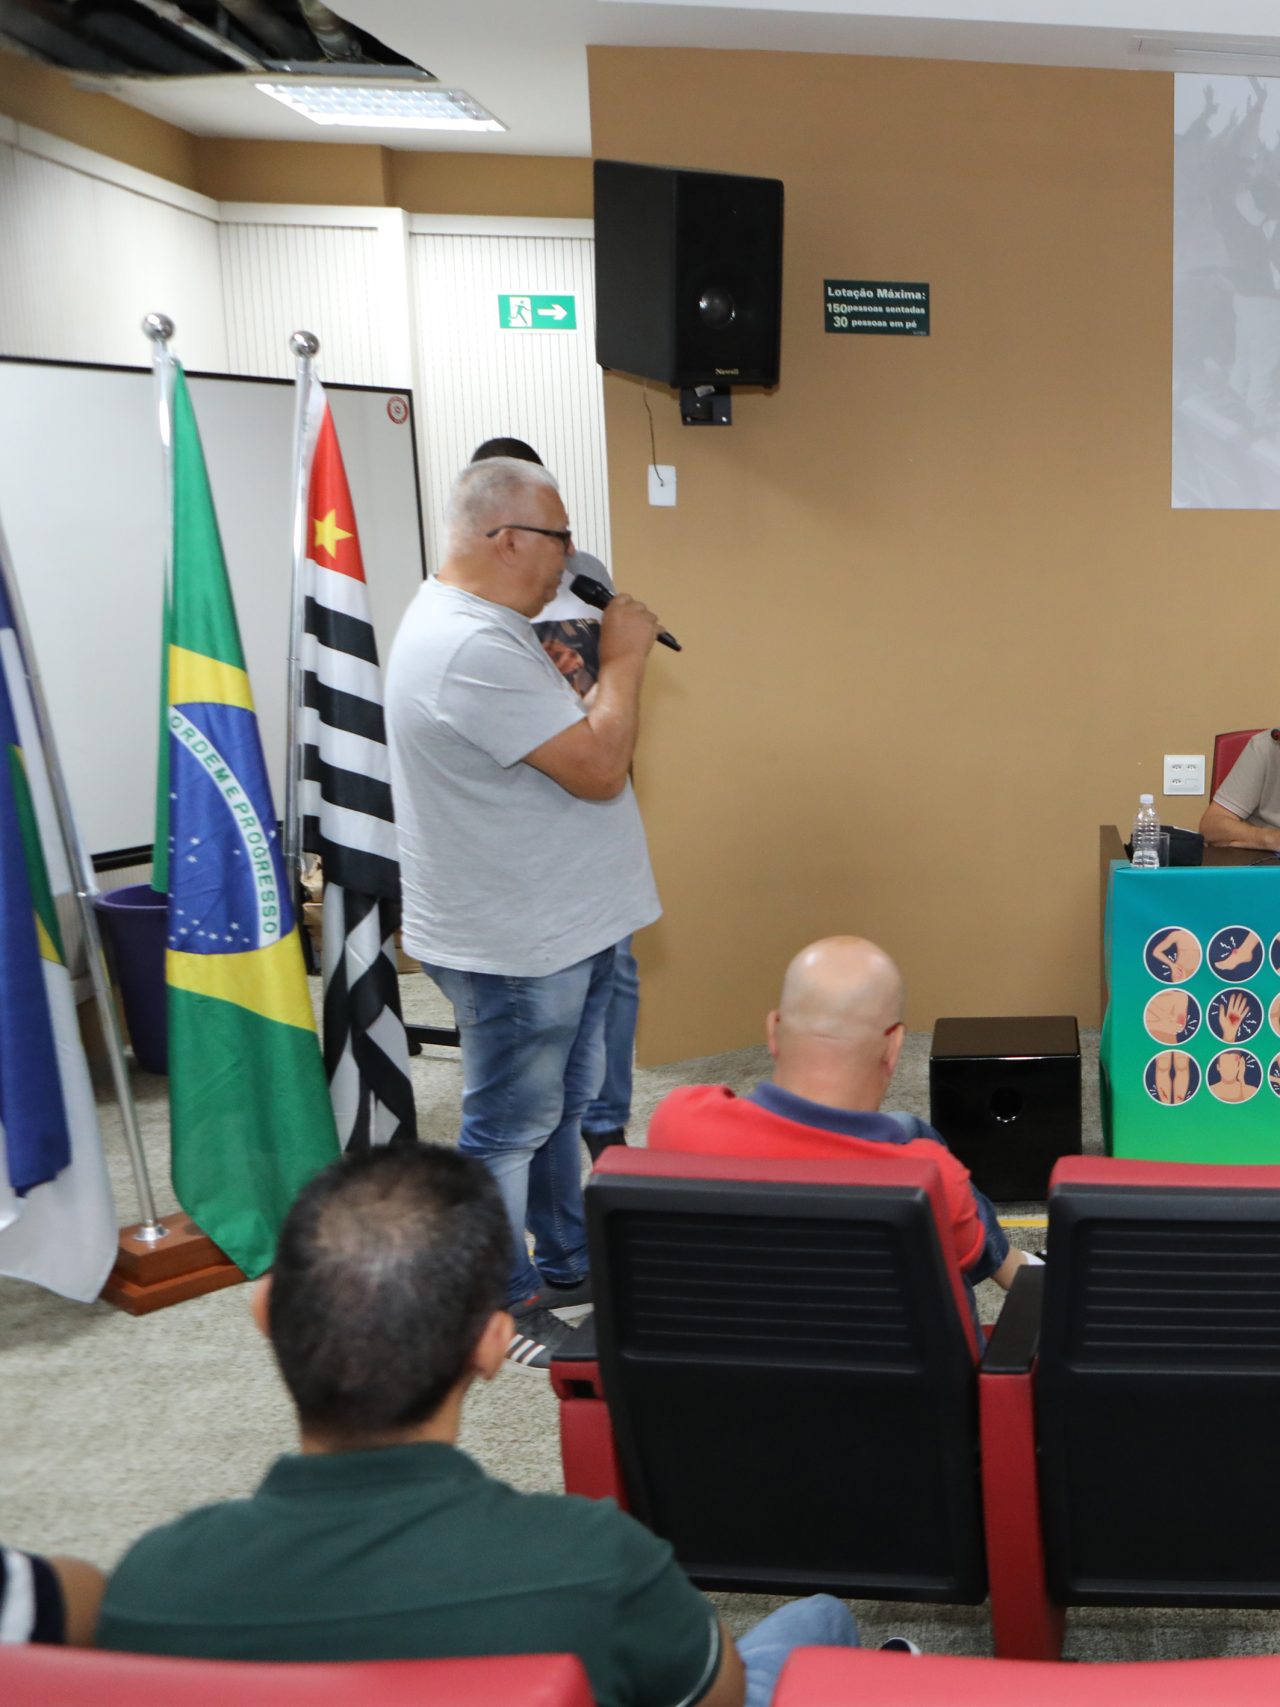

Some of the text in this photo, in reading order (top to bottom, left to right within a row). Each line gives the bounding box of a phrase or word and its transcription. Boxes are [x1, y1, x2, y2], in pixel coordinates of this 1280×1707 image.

[828, 287, 926, 299] Lotação Máxima:
[885, 305, 925, 314] sentadas
[833, 316, 848, 328] 30
[851, 318, 887, 328] pessoas
[171, 714, 279, 934] ORDEM E PROGRESSO
